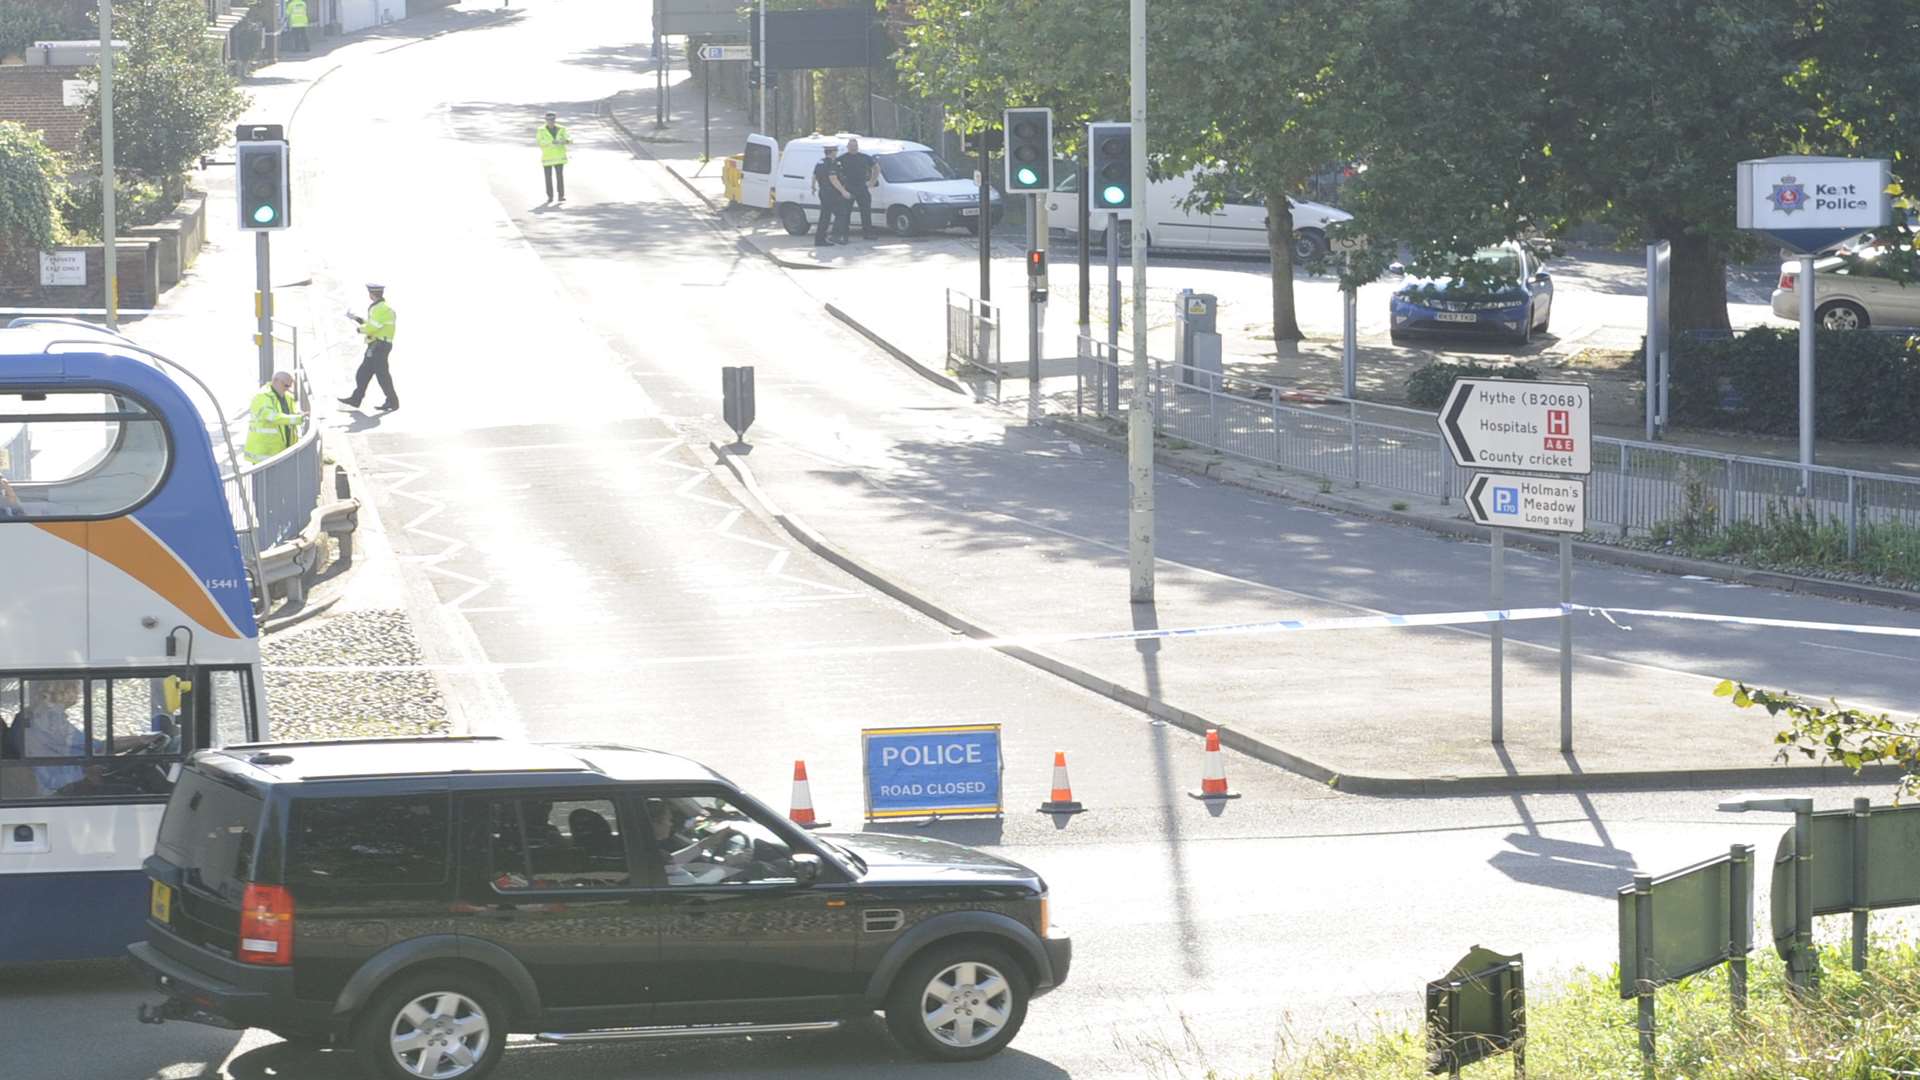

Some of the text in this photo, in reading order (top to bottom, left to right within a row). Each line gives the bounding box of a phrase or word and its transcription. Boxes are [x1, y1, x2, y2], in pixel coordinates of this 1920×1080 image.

[1816, 184, 1856, 195] Kent
[1816, 198, 1867, 210] Police
[1479, 391, 1584, 409] Hythe (B2068)
[1480, 419, 1538, 434] Hospitals
[1549, 411, 1568, 435] H
[1546, 439, 1573, 449] A&E
[1479, 450, 1573, 467] County cricket
[1521, 482, 1579, 498] Holman's
[1496, 489, 1512, 512] P
[1523, 498, 1576, 513] Meadow
[1525, 513, 1575, 528] Long stay
[206, 579, 238, 589] 15441
[881, 743, 983, 767] POLICE
[880, 781, 986, 797] ROAD CLOSED
